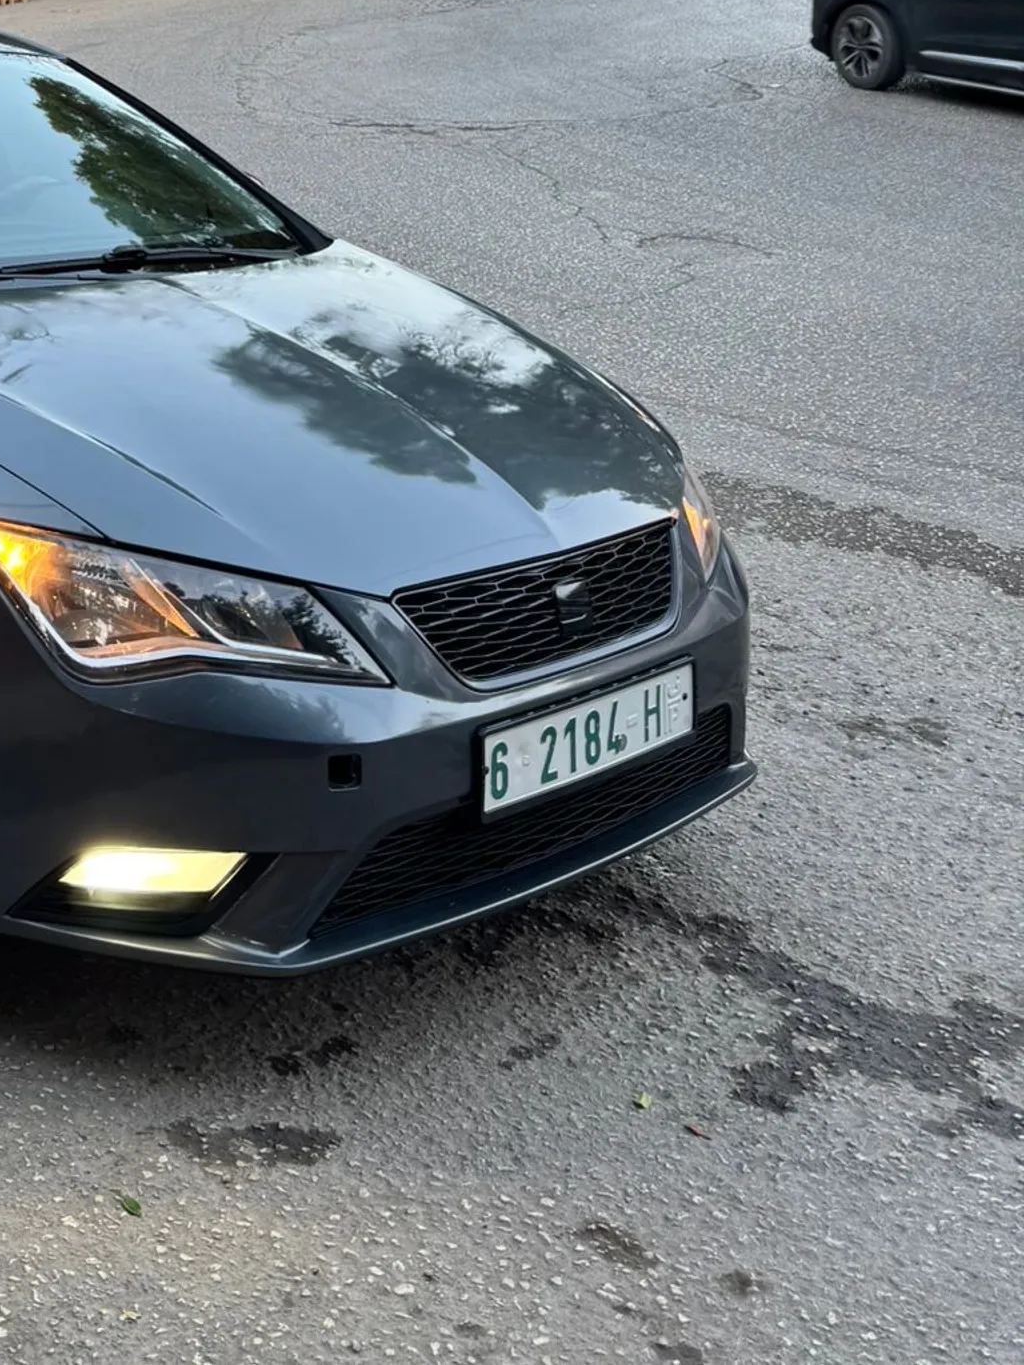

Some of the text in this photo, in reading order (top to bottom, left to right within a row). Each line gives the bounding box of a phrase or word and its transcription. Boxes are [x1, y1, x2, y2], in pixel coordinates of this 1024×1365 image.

[490, 684, 662, 800] 6 2184 H
